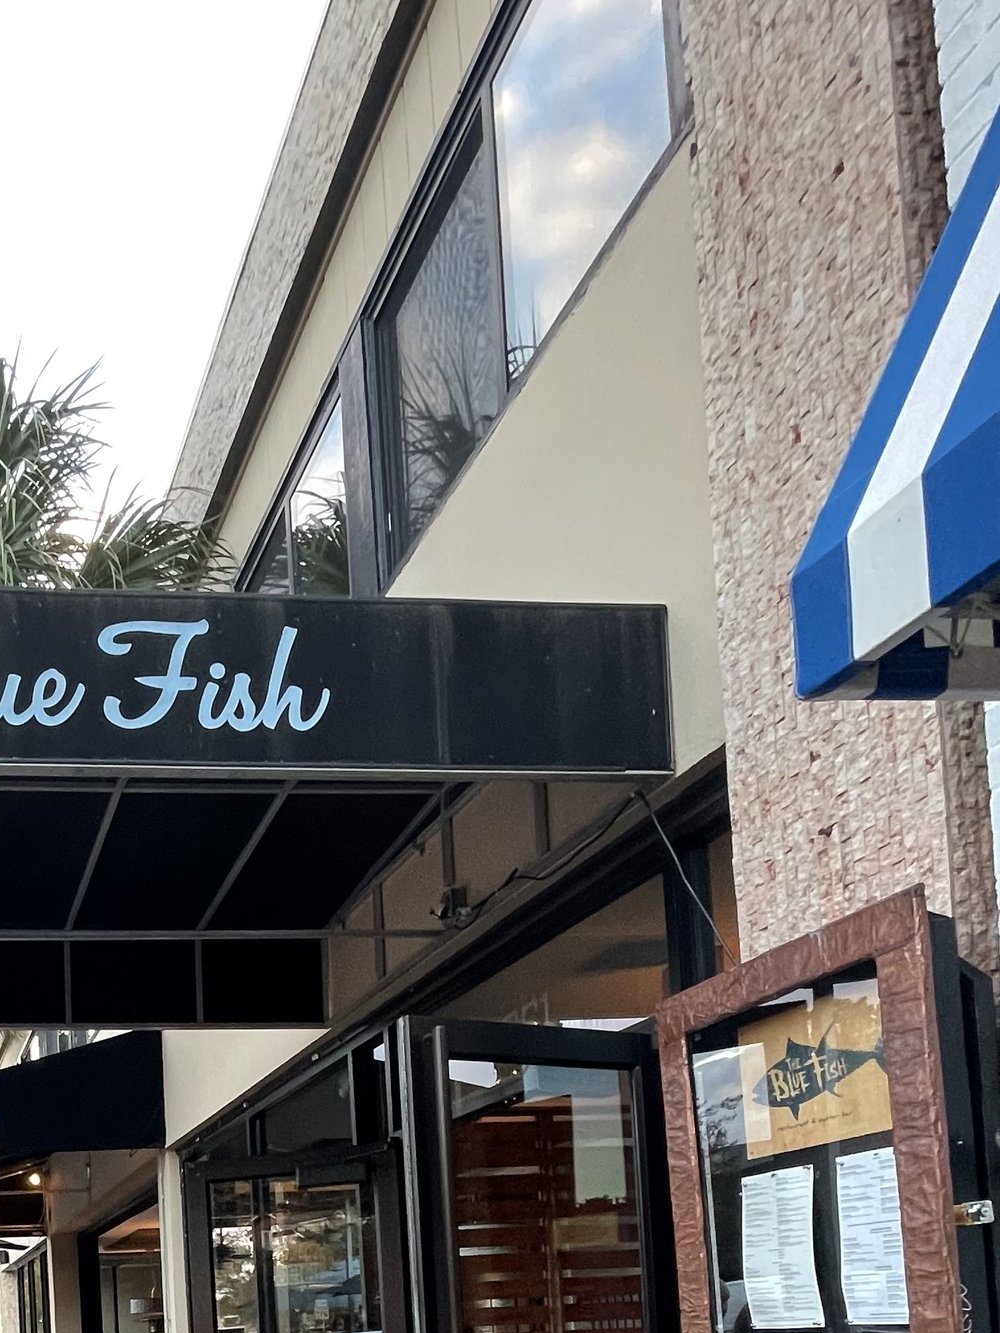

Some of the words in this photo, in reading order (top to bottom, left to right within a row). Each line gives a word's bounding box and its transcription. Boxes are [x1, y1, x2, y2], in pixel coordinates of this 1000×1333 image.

[96, 618, 331, 733] Fish
[767, 1068, 810, 1102] BLUE
[803, 1051, 847, 1091] FISH
